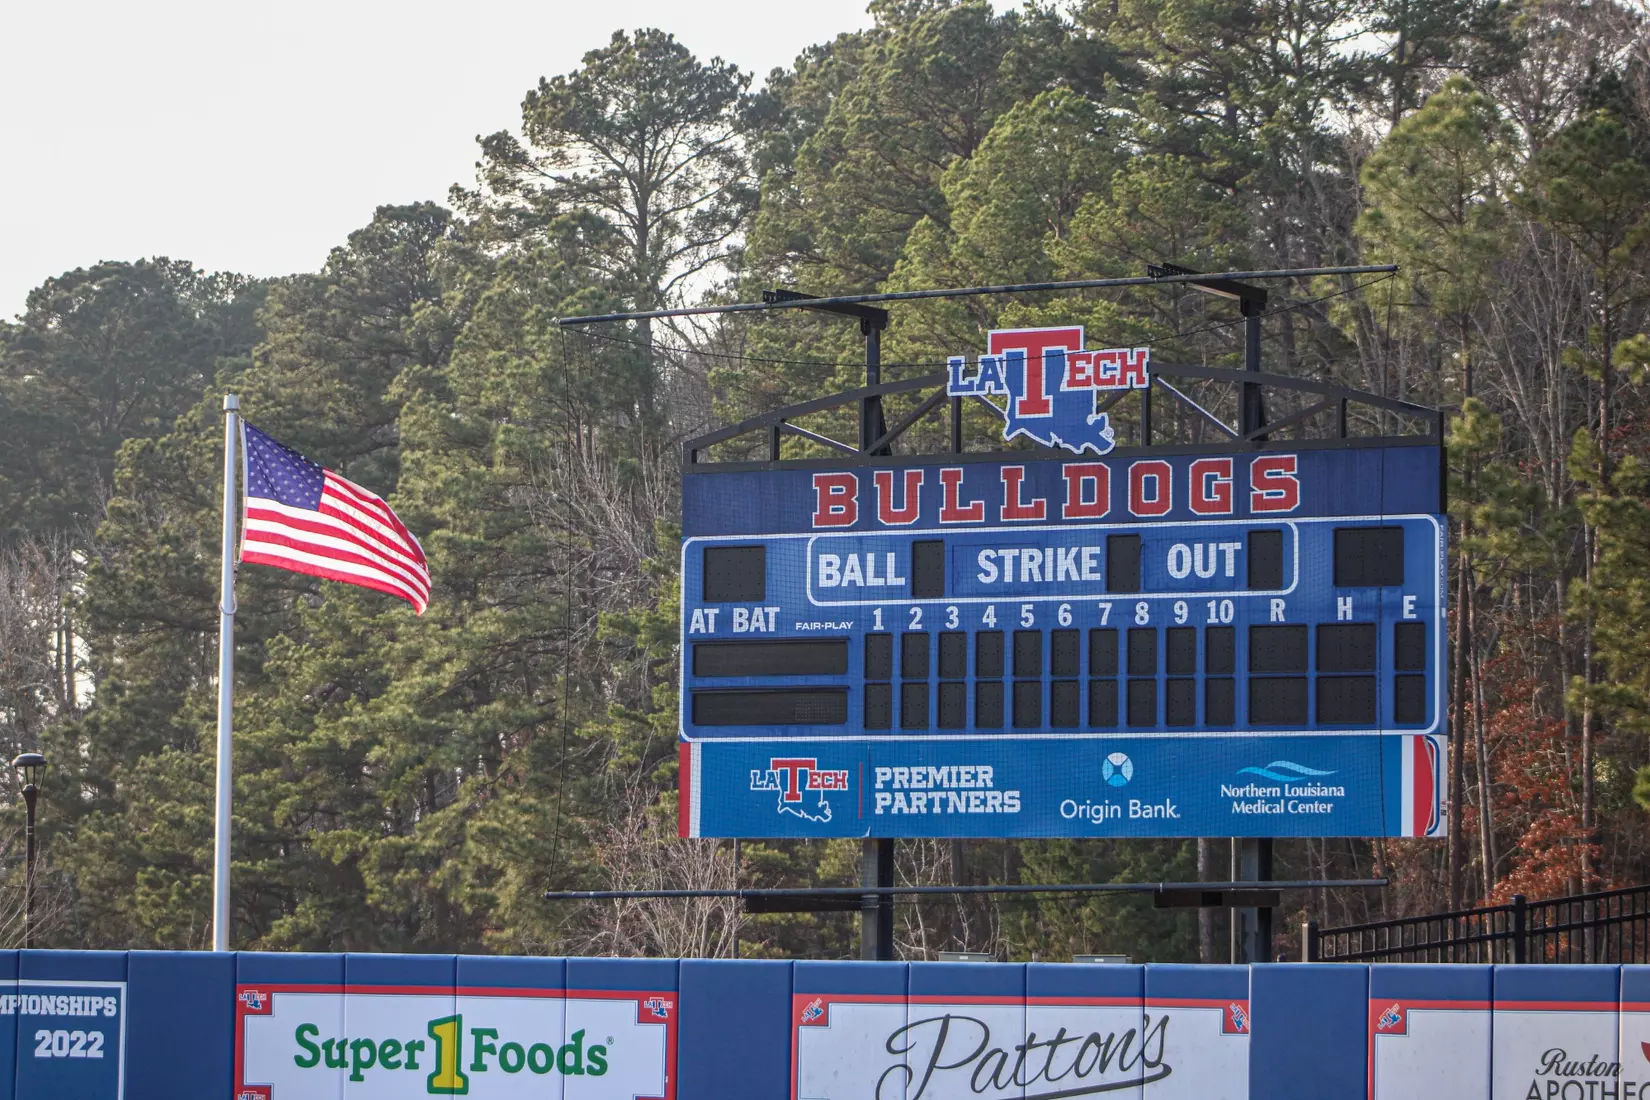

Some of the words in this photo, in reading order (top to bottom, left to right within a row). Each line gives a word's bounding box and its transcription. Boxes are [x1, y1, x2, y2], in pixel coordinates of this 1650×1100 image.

[947, 356, 1008, 396] LA
[988, 325, 1150, 419] TECH
[812, 454, 1300, 528] BULLDOGS
[818, 552, 905, 587] BALL
[977, 546, 1101, 584] STRIKE
[1167, 542, 1241, 579] OUT
[689, 608, 719, 634] AT
[733, 606, 780, 633] BAT
[873, 607, 884, 631] 1
[908, 606, 923, 630] 2
[945, 605, 959, 629] 3
[982, 604, 997, 628] 4
[1020, 604, 1034, 628] 5
[1058, 602, 1072, 627] 6
[1098, 602, 1112, 626] 7
[1134, 601, 1149, 625] 8
[1173, 600, 1188, 624] 9
[1207, 599, 1234, 624] 10
[1270, 598, 1286, 622] R
[1337, 596, 1352, 620] H
[1403, 595, 1416, 619] E
[750, 769, 780, 790] LA
[770, 757, 848, 802] TECH
[875, 765, 994, 789] PREMIER
[1220, 783, 1280, 798] Northern
[1284, 782, 1345, 797] Louisiana
[875, 791, 1021, 815] PARTNERS
[1060, 799, 1121, 824] Origin
[1231, 799, 1285, 814] Medical
[1287, 799, 1333, 813] Center
[34, 1029, 104, 1058] 2022
[294, 1023, 425, 1082] Super
[427, 1013, 469, 1095] 1
[876, 1013, 1172, 1100] Patton's
[1535, 1048, 1624, 1077] Ruston
